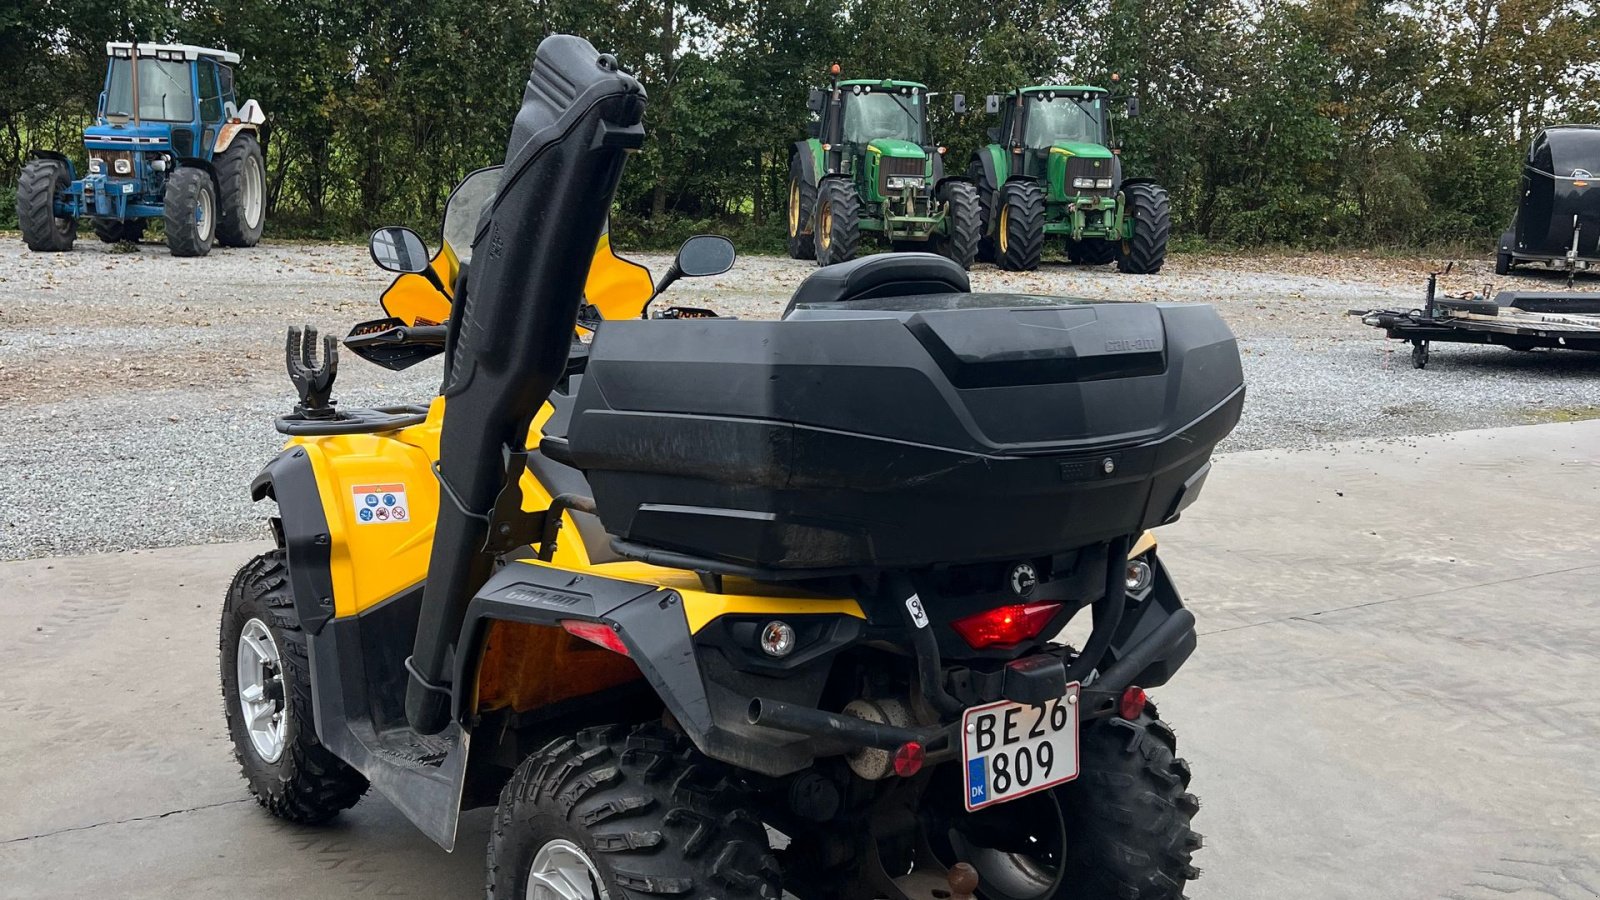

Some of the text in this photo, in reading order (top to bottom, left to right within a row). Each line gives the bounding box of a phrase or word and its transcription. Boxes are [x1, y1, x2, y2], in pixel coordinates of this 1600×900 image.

[976, 697, 1067, 753] BE 26
[971, 785, 984, 798] DK
[992, 740, 1054, 794] 809
